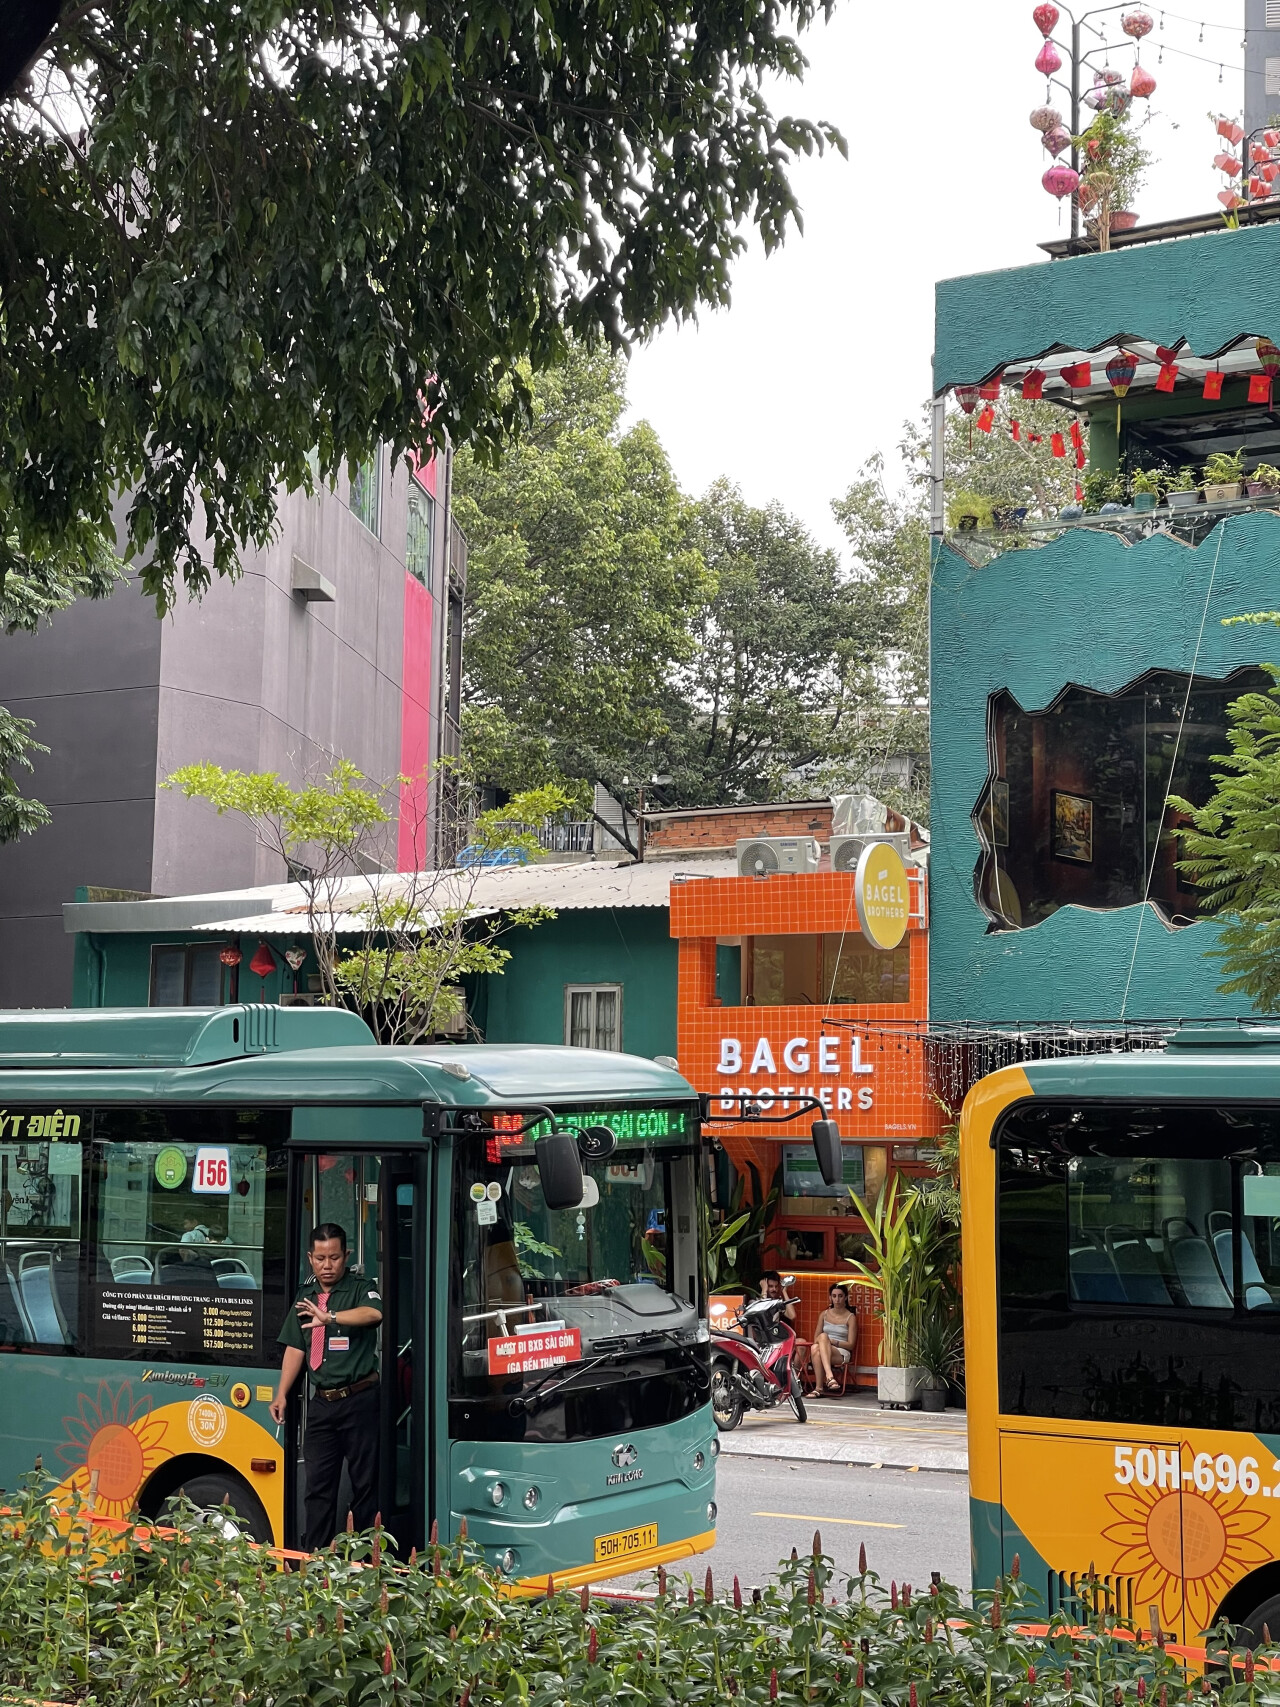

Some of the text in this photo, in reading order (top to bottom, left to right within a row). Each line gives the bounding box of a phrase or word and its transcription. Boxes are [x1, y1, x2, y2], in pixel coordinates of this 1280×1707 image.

[866, 884, 904, 903] BAGEL
[867, 906, 905, 918] BROTHERS
[716, 1036, 874, 1074] BAGEL
[720, 1086, 874, 1110] BROTHERS
[198, 1160, 228, 1186] 156
[132, 1312, 147, 1322] 5.000
[203, 1306, 218, 1316] 3.000
[132, 1324, 147, 1332] 6.000
[203, 1318, 224, 1327] 112.500
[132, 1334, 147, 1344] 7.000
[203, 1328, 224, 1338] 135.000
[203, 1340, 224, 1349] 157.500
[518, 1341, 527, 1354] ĐI
[528, 1338, 543, 1352] BXB
[545, 1335, 557, 1350] SÀI
[558, 1332, 574, 1347] GÒN
[523, 1355, 538, 1372] BẾN
[200, 1421, 215, 1430] 30N
[623, 1468, 644, 1482] LONG
[600, 1529, 652, 1556] 50H-705.11
